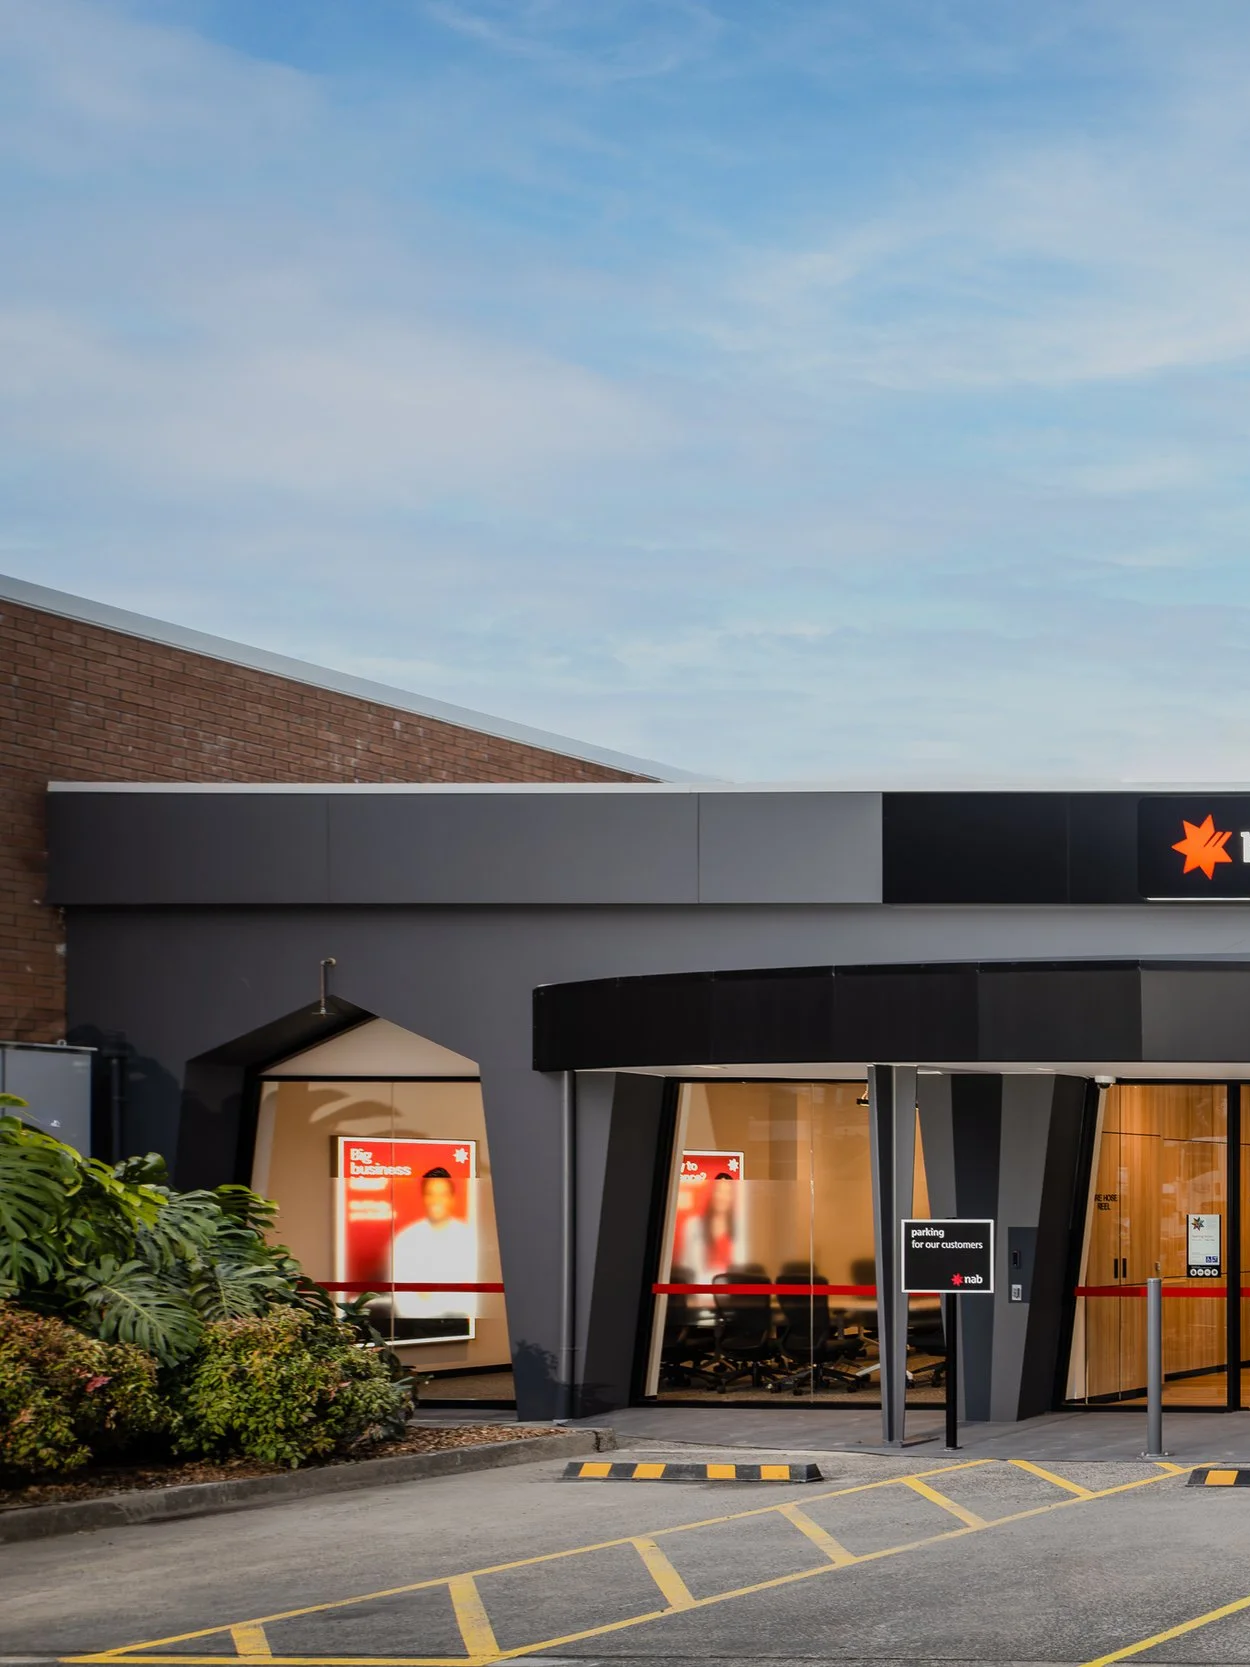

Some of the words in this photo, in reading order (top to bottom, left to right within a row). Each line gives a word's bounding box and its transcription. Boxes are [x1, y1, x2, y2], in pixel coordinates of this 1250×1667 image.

[350, 1148, 373, 1164] Big
[350, 1162, 412, 1175] business
[911, 1227, 945, 1239] parking
[911, 1240, 924, 1249] for
[925, 1241, 940, 1249] our
[941, 1241, 983, 1249] customers
[964, 1274, 983, 1284] nab
